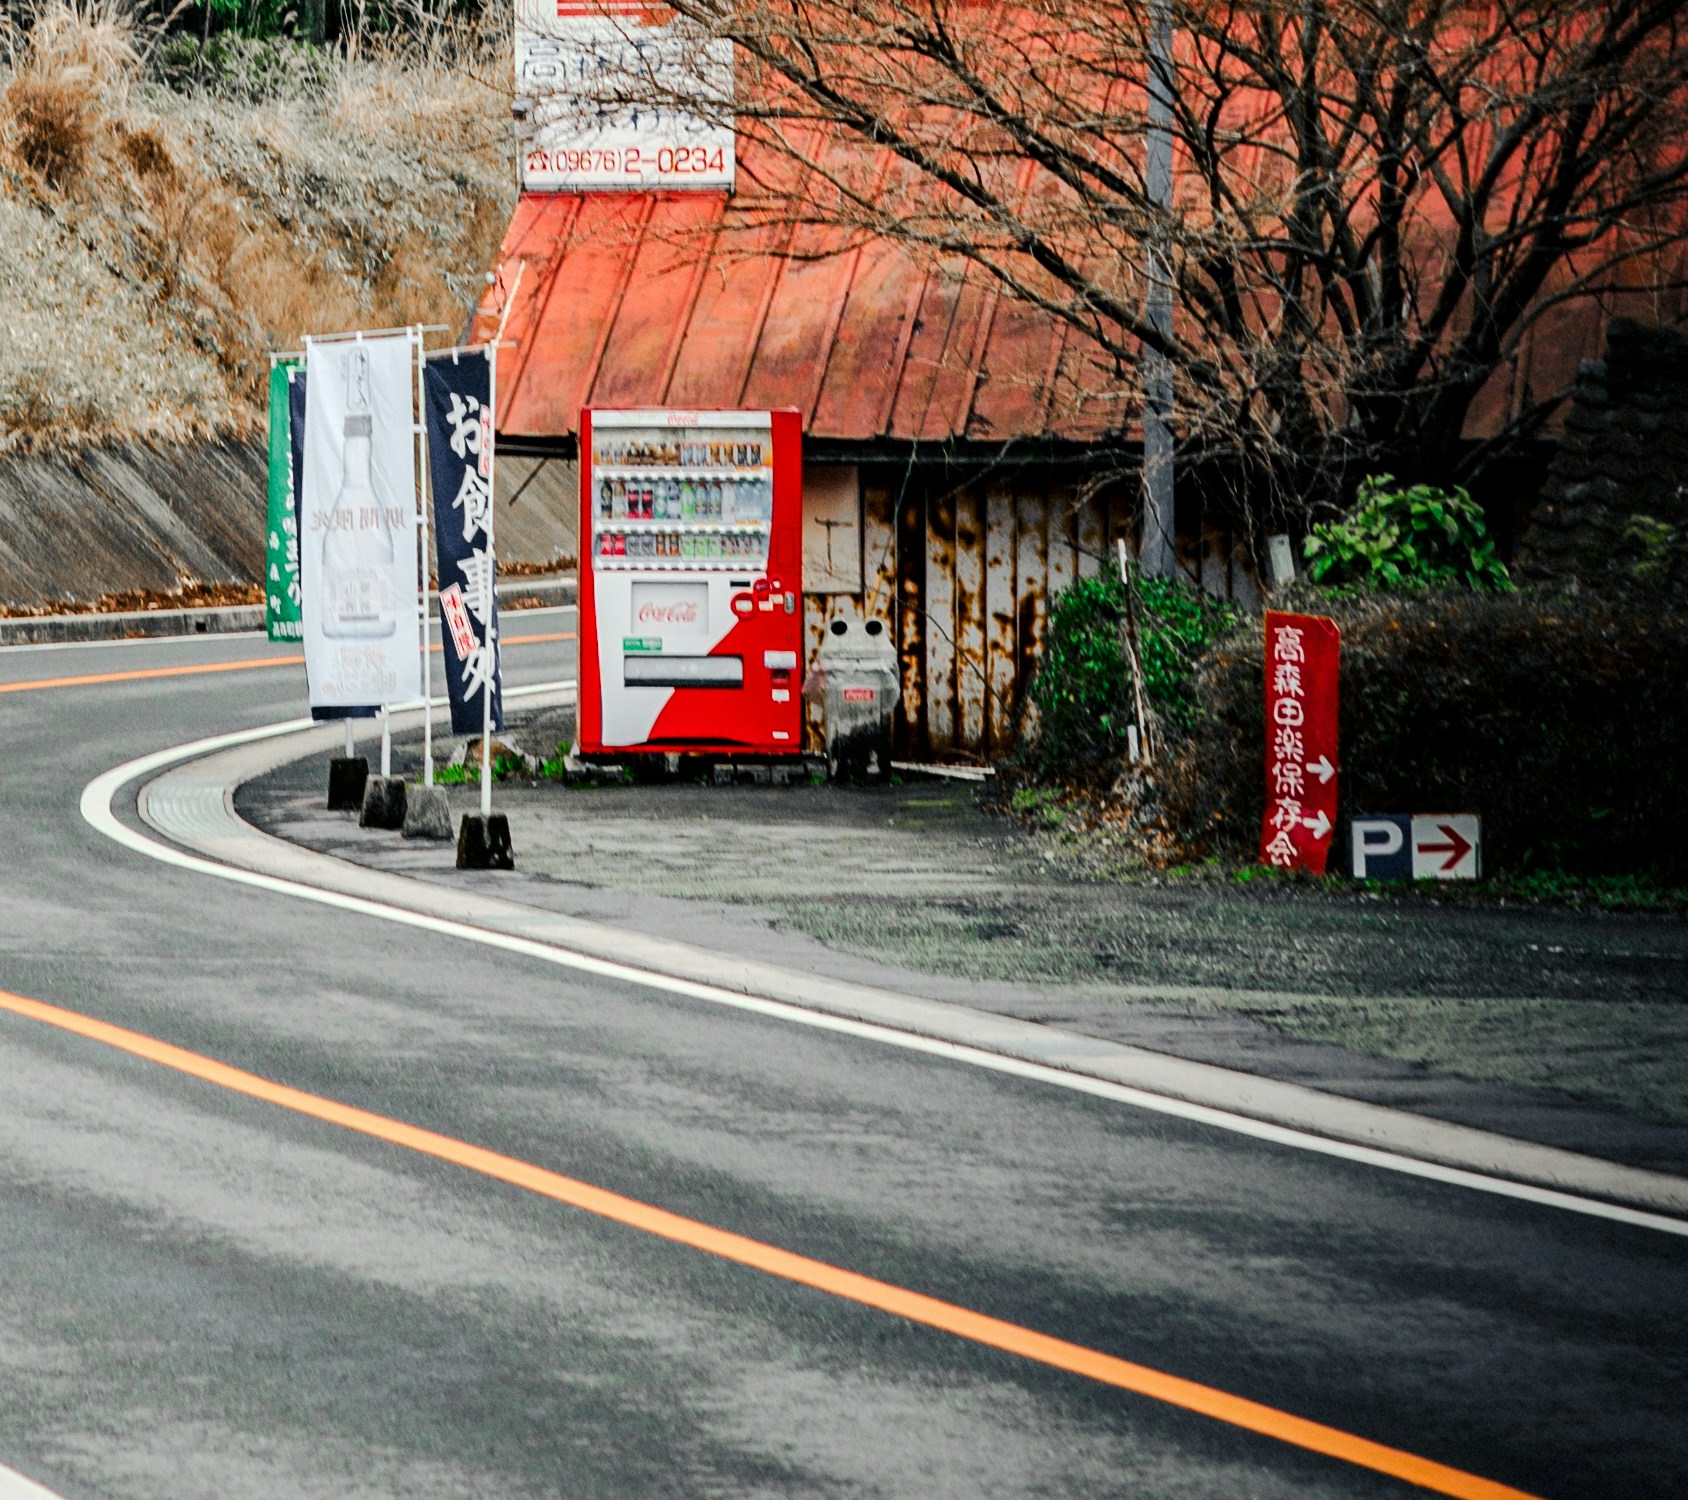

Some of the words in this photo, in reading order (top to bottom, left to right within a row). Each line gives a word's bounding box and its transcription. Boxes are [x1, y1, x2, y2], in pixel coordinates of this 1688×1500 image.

[1265, 625, 1305, 867] 高森田楽保存会
[1351, 820, 1404, 878] P
